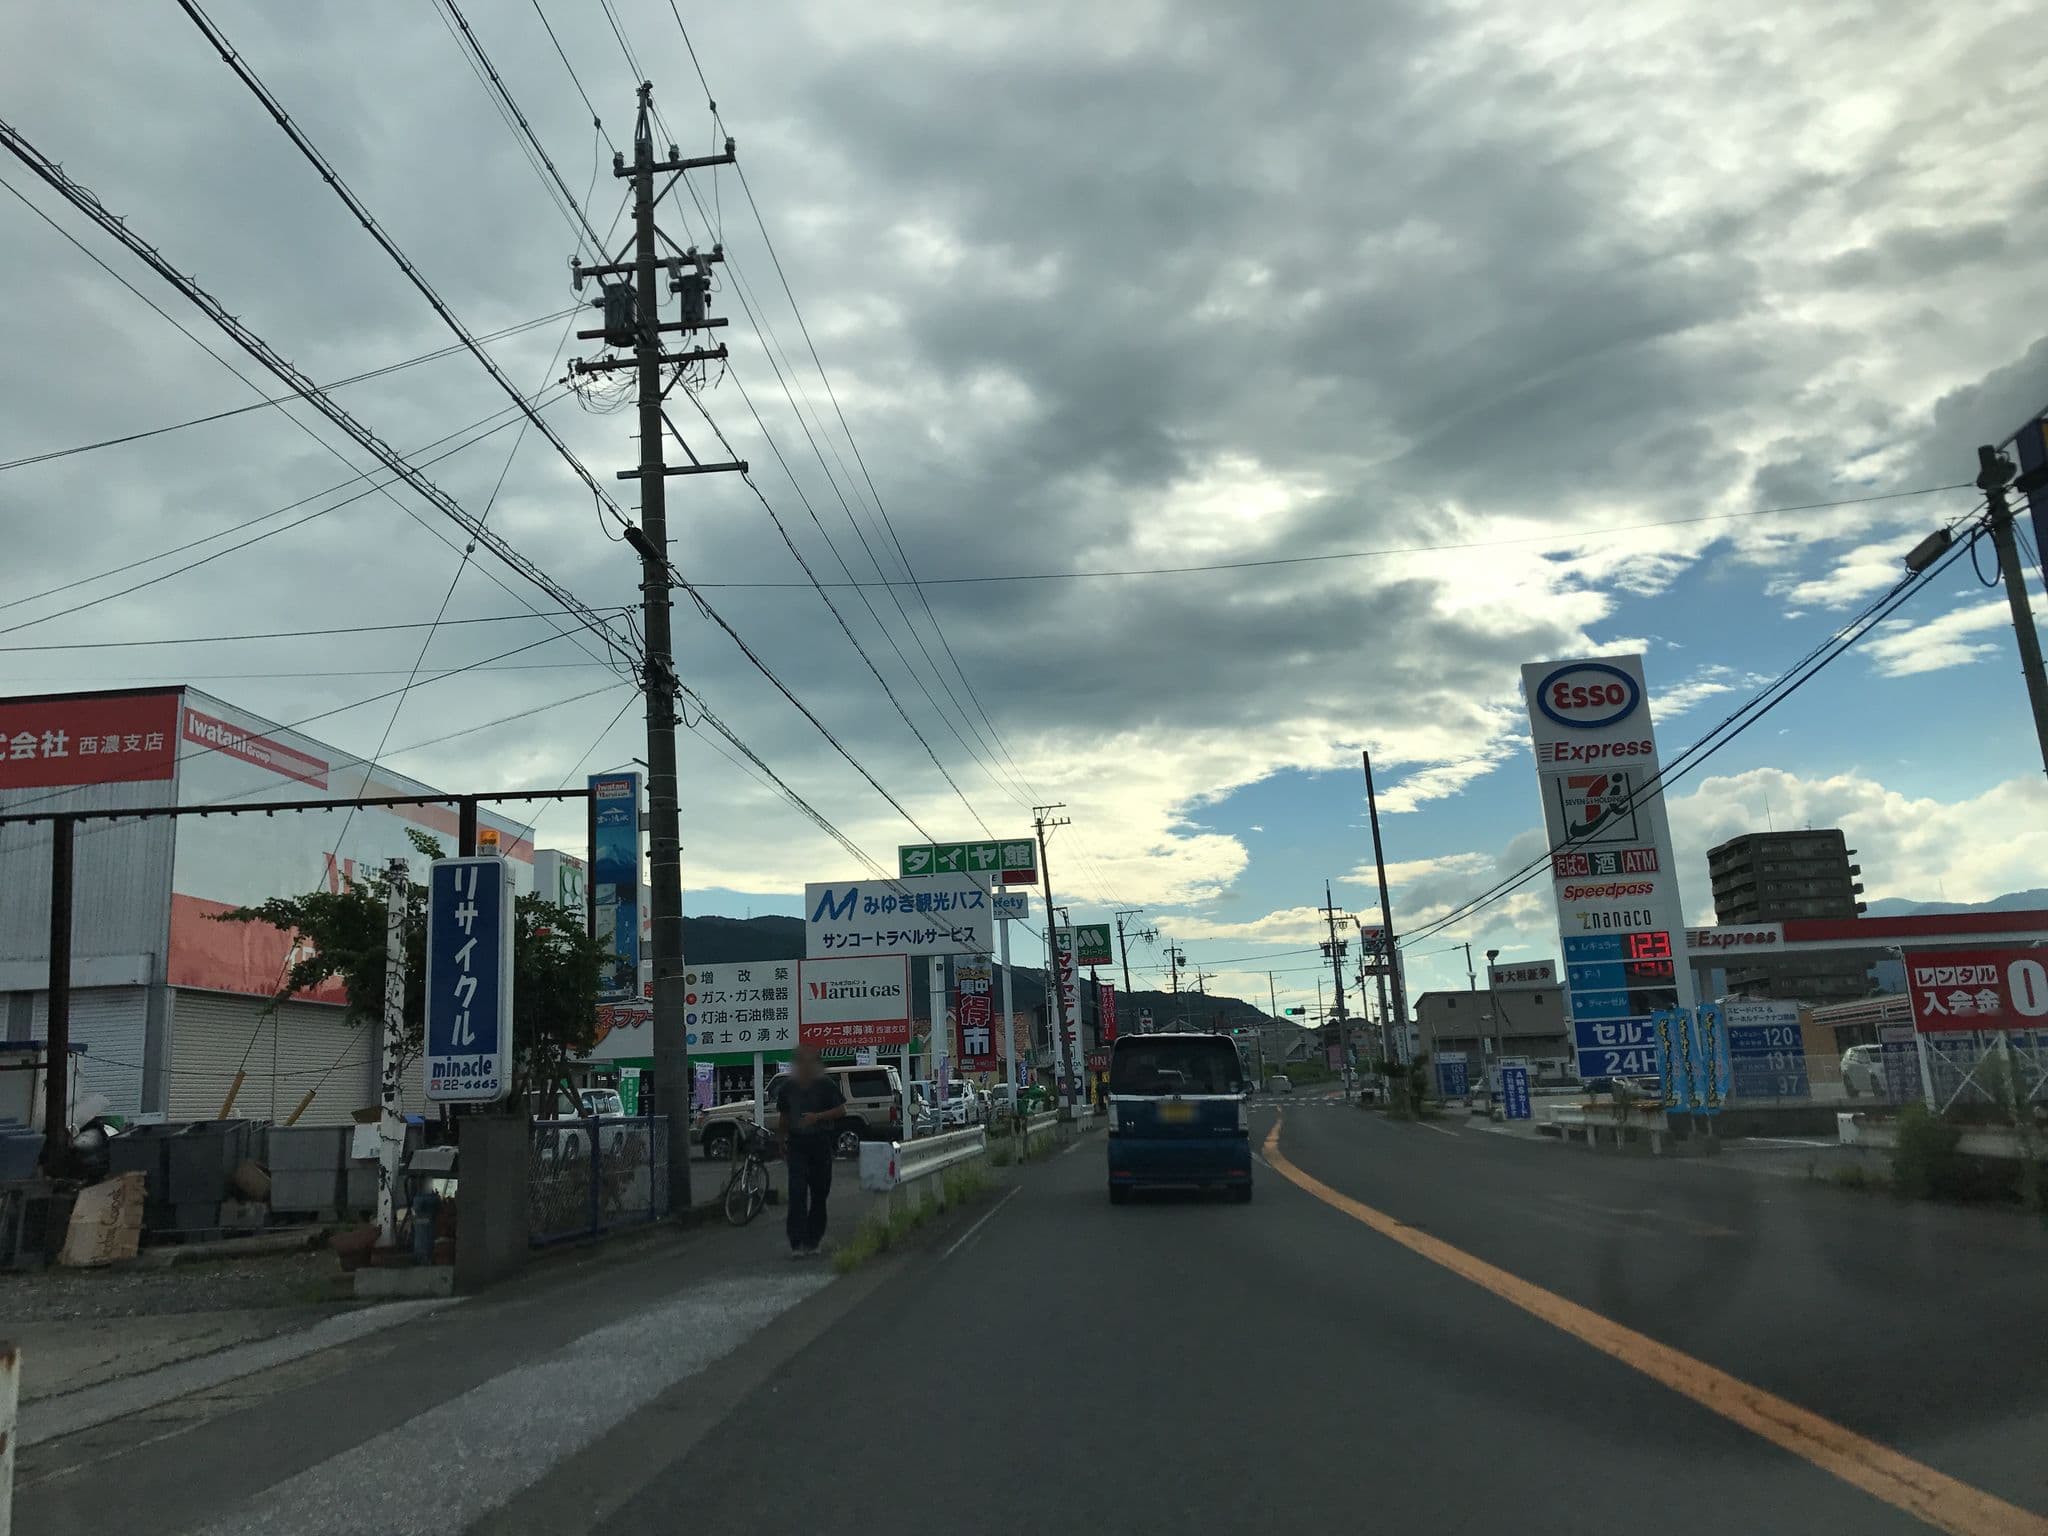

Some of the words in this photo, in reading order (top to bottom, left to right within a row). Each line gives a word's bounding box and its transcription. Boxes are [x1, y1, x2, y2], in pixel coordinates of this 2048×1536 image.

[1553, 682, 1625, 709] Esso
[188, 713, 247, 753] Iwatani
[0, 729, 70, 760] 会社
[1554, 739, 1653, 764] Express
[905, 844, 1031, 872] タイヤ館
[1555, 854, 1588, 877] たばこ
[1596, 852, 1617, 875] 酒
[1625, 850, 1657, 872] ATM
[1563, 882, 1654, 900] Speedpass
[863, 890, 984, 916] みゆき観光バス
[1592, 910, 1651, 929] nanaco
[823, 927, 976, 949] サンコートラベルサービス
[1630, 932, 1671, 958] 123
[1699, 930, 1776, 949] Express
[454, 866, 479, 1046] リサイクル
[701, 967, 789, 985] 増改築
[1918, 967, 1996, 985] レンタル
[701, 987, 789, 1004] ガス・ガス機器
[808, 982, 868, 1001] Marui
[1922, 989, 2000, 1017] 入会金
[701, 1007, 789, 1024] 灯油・石油機器
[701, 1028, 789, 1045] 富士の湧水
[1763, 1027, 1794, 1046] 120
[432, 1055, 492, 1078] minacle
[443, 1079, 498, 1090] 22-6665
[1777, 1075, 1798, 1094] 97
